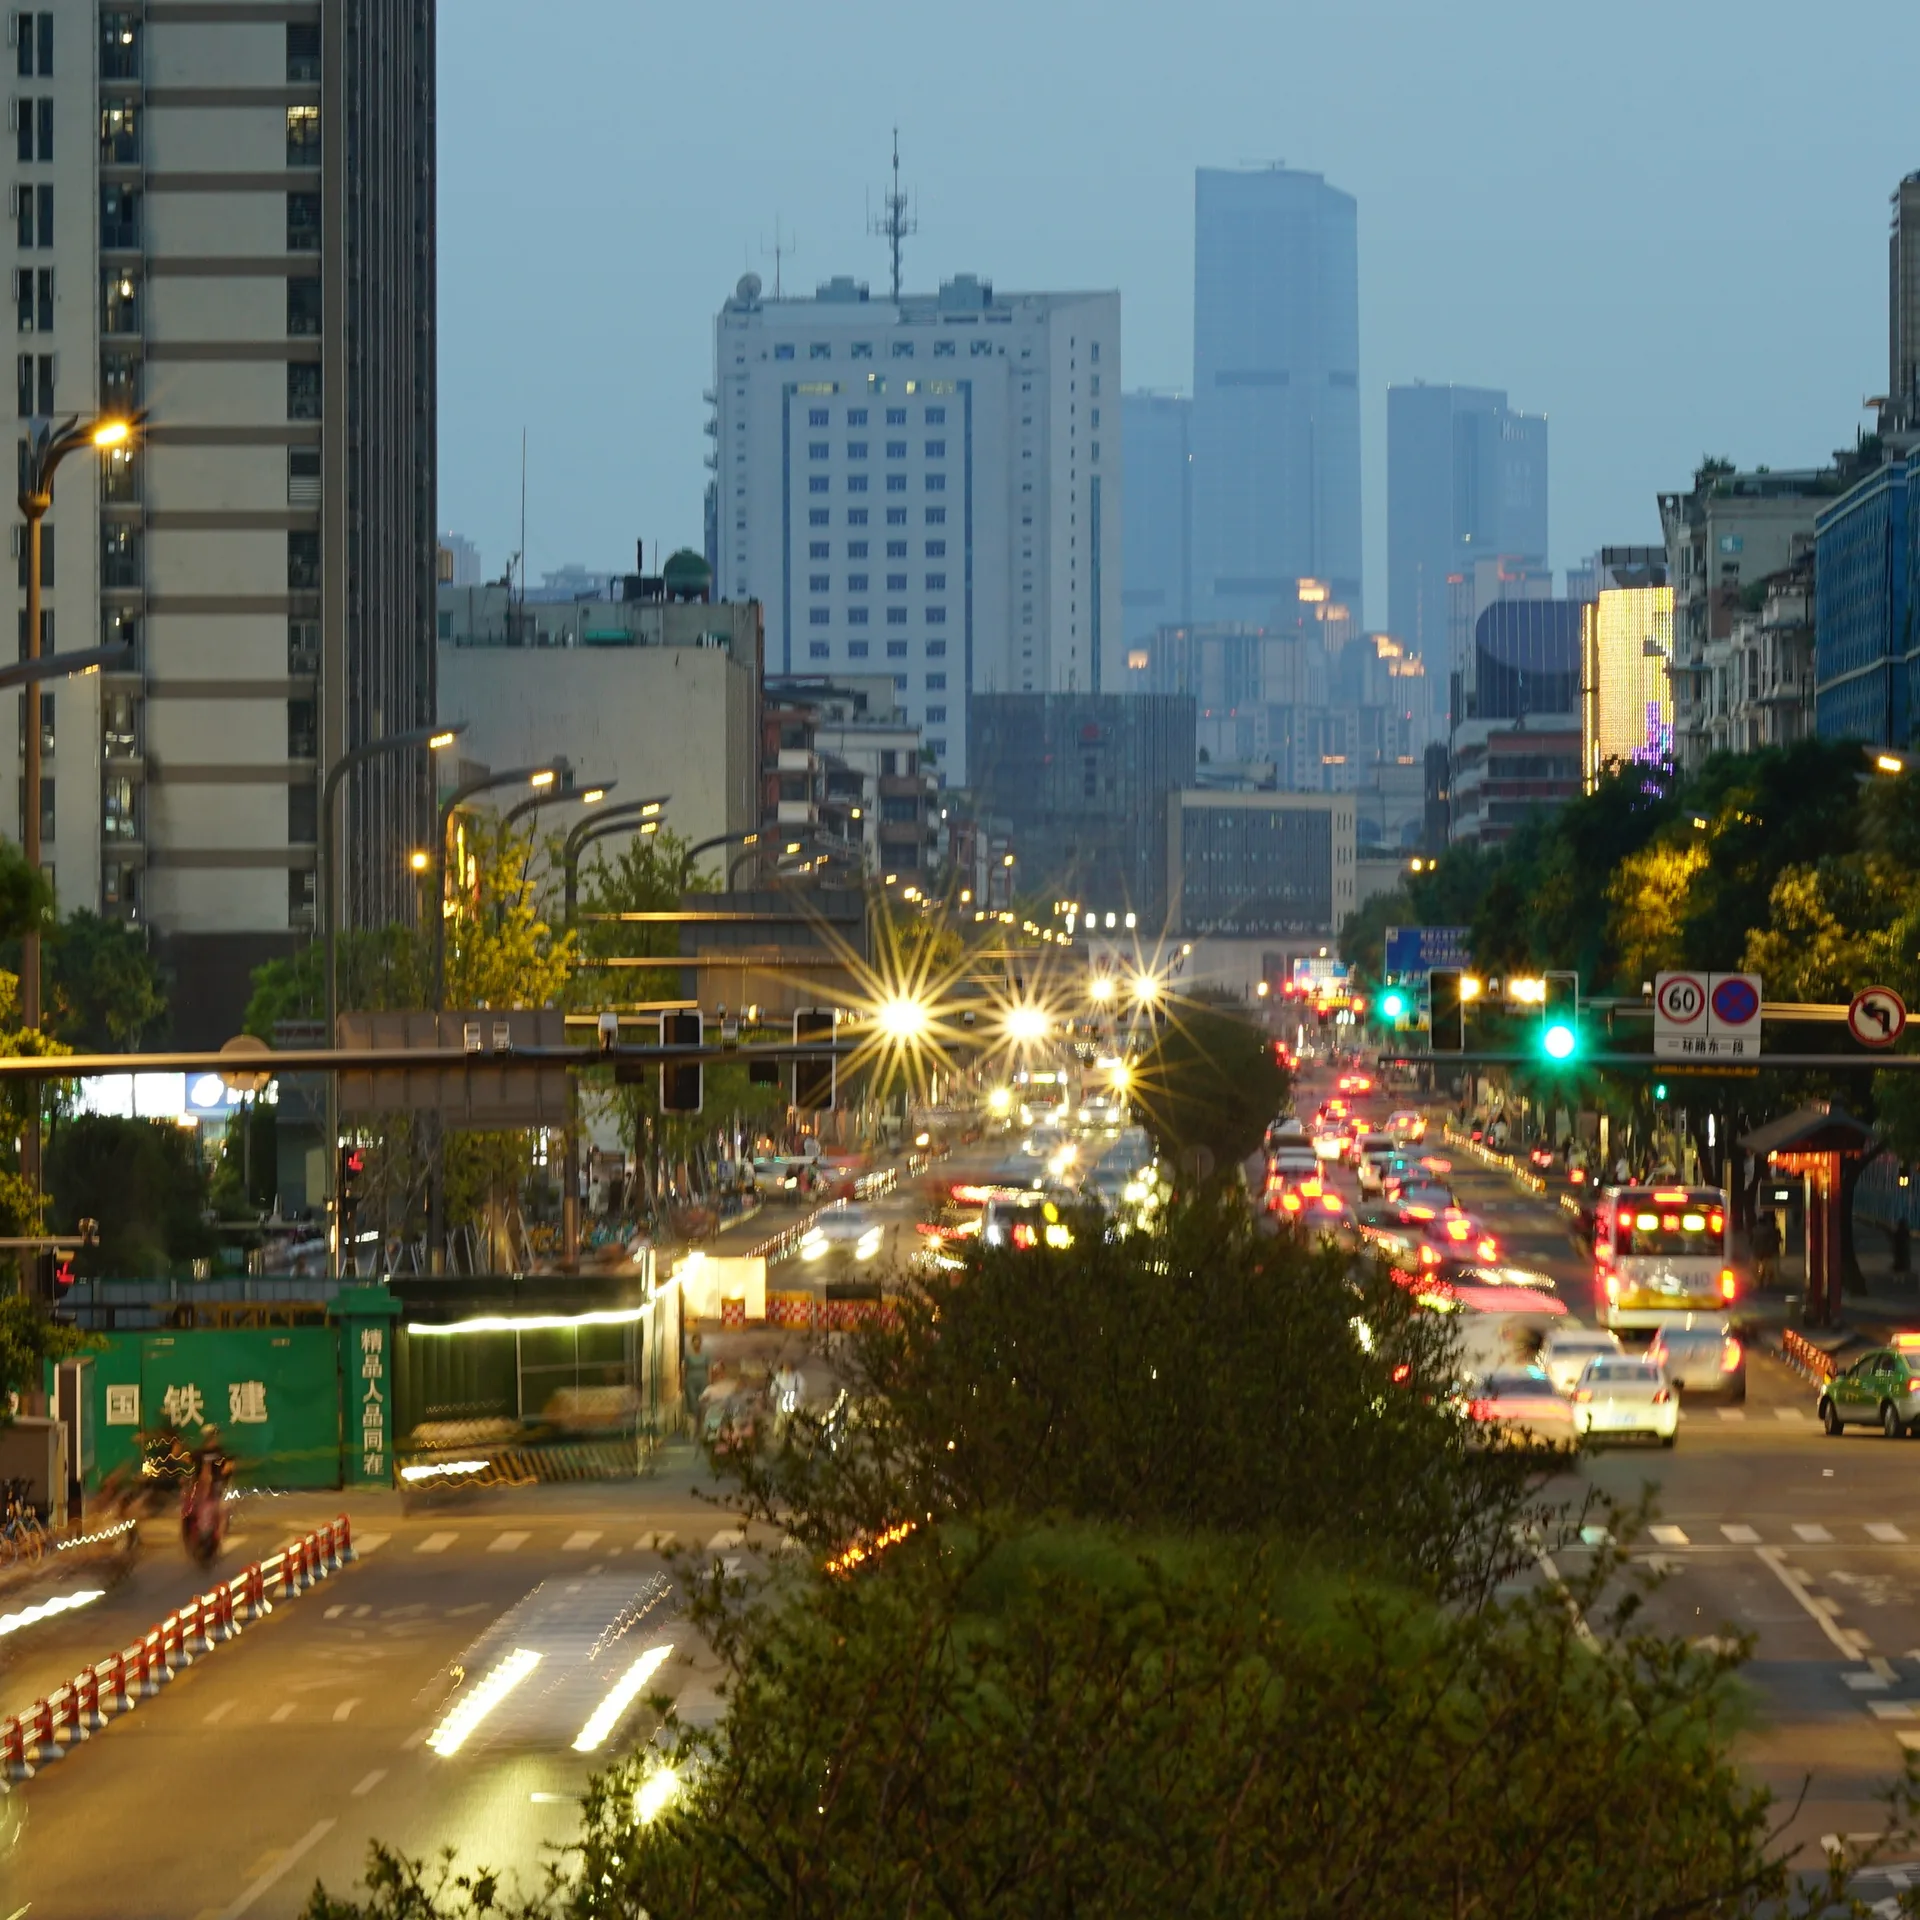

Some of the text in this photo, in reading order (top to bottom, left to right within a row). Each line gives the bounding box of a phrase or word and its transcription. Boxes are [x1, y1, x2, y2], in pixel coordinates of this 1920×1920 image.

[1669, 986, 1695, 1012] 60
[361, 1328, 384, 1475] 精品人品同在
